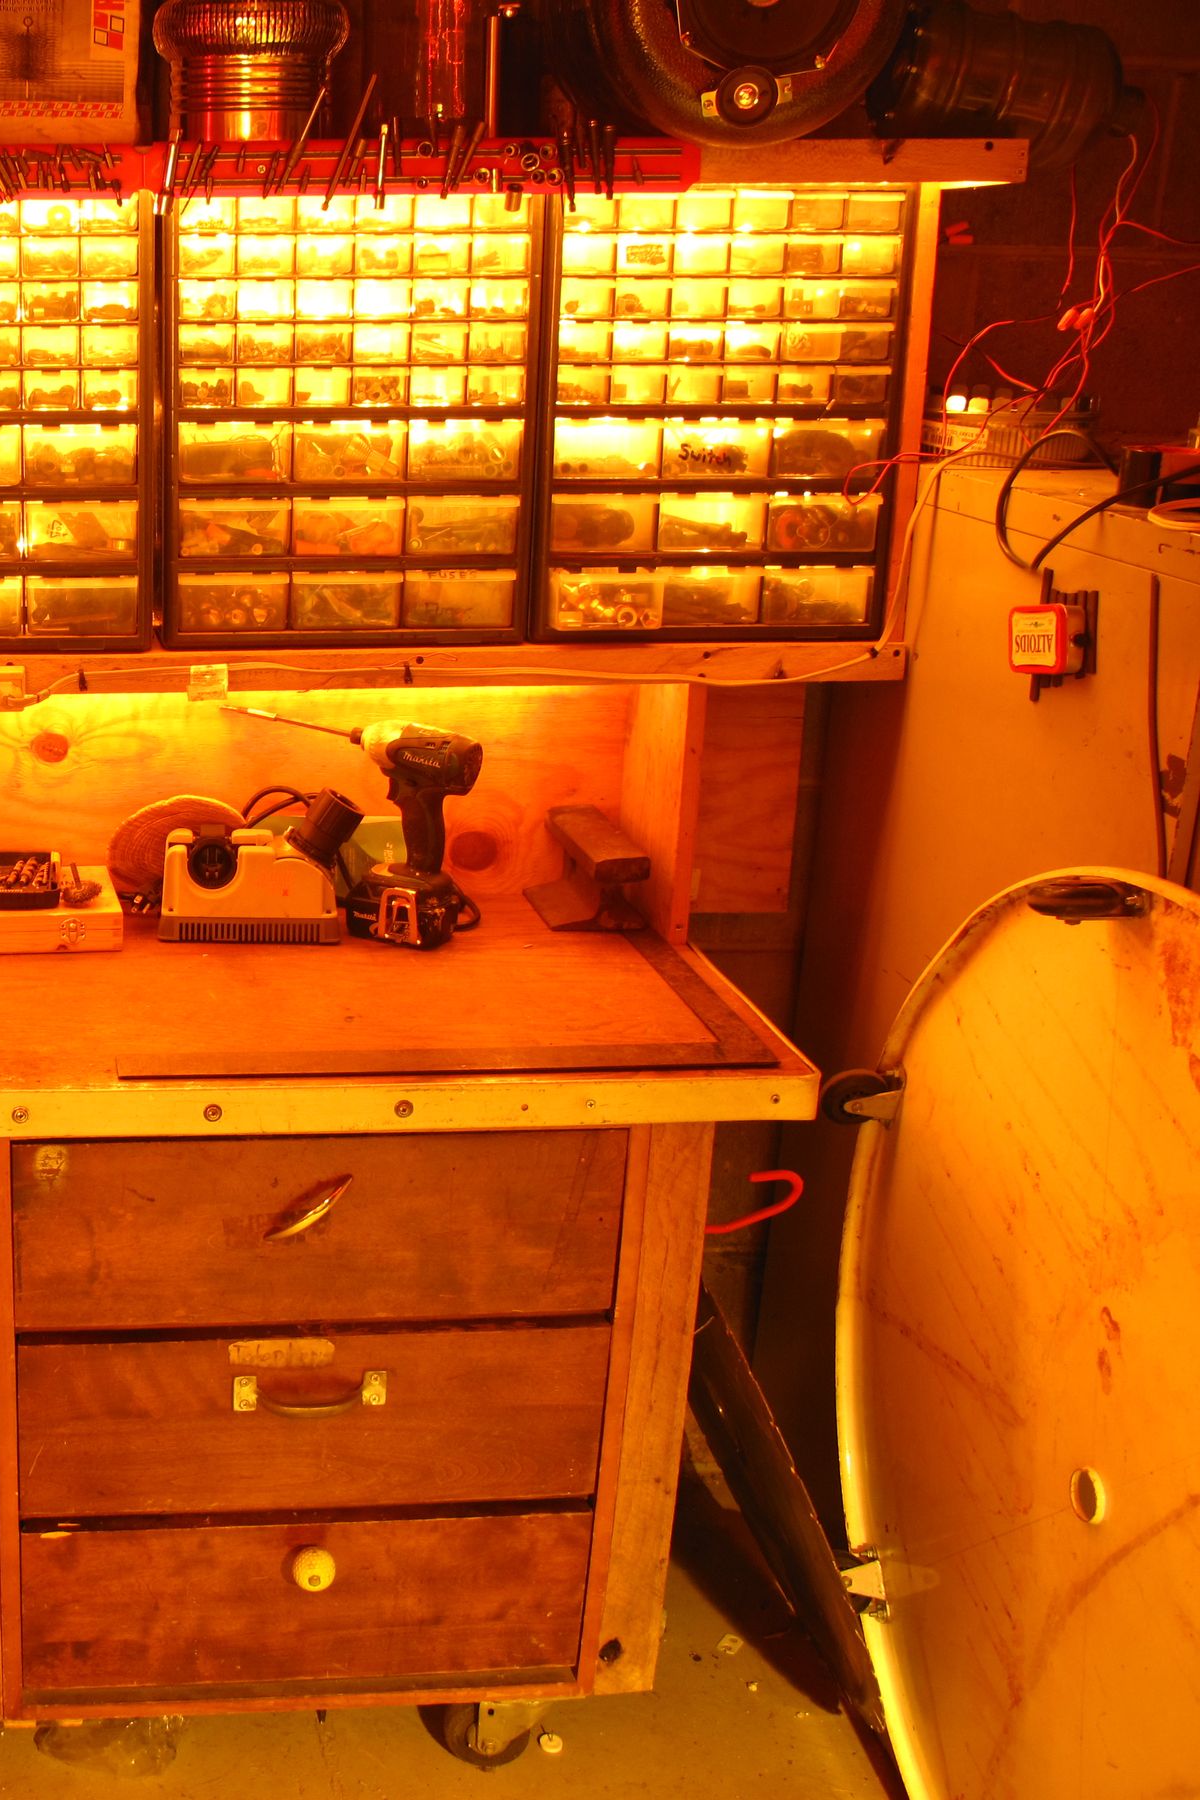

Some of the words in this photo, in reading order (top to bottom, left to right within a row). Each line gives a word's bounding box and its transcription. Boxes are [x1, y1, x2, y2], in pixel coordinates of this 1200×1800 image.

[678, 443, 733, 467] Switch
[427, 571, 478, 579] FUSES
[1014, 633, 1054, 653] ALTOIDS
